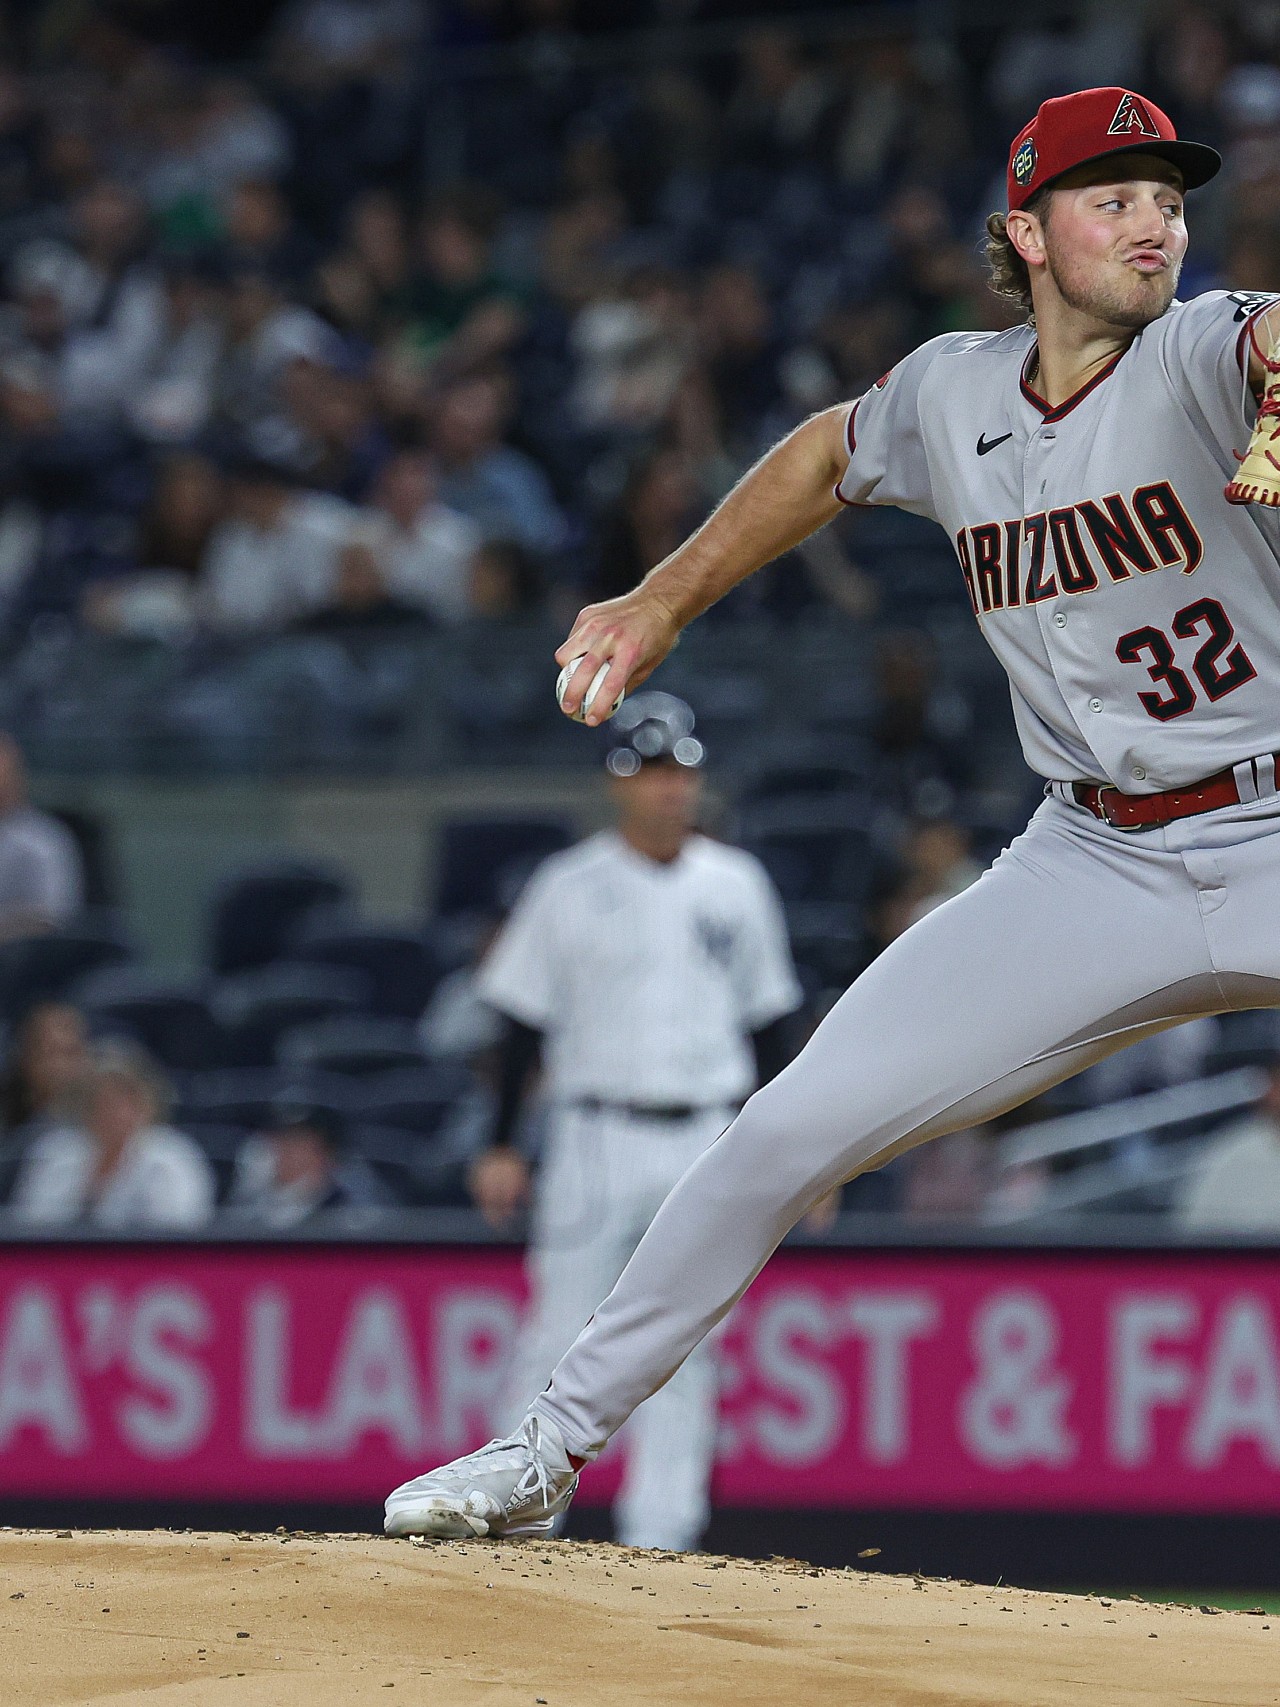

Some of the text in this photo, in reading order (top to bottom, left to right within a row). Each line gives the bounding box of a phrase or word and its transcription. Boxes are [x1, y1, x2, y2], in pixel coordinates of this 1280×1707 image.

[1016, 146, 1033, 178] 25
[956, 479, 1203, 617] ARIZONA
[1115, 597, 1258, 722] 32
[960, 1286, 1077, 1468] &
